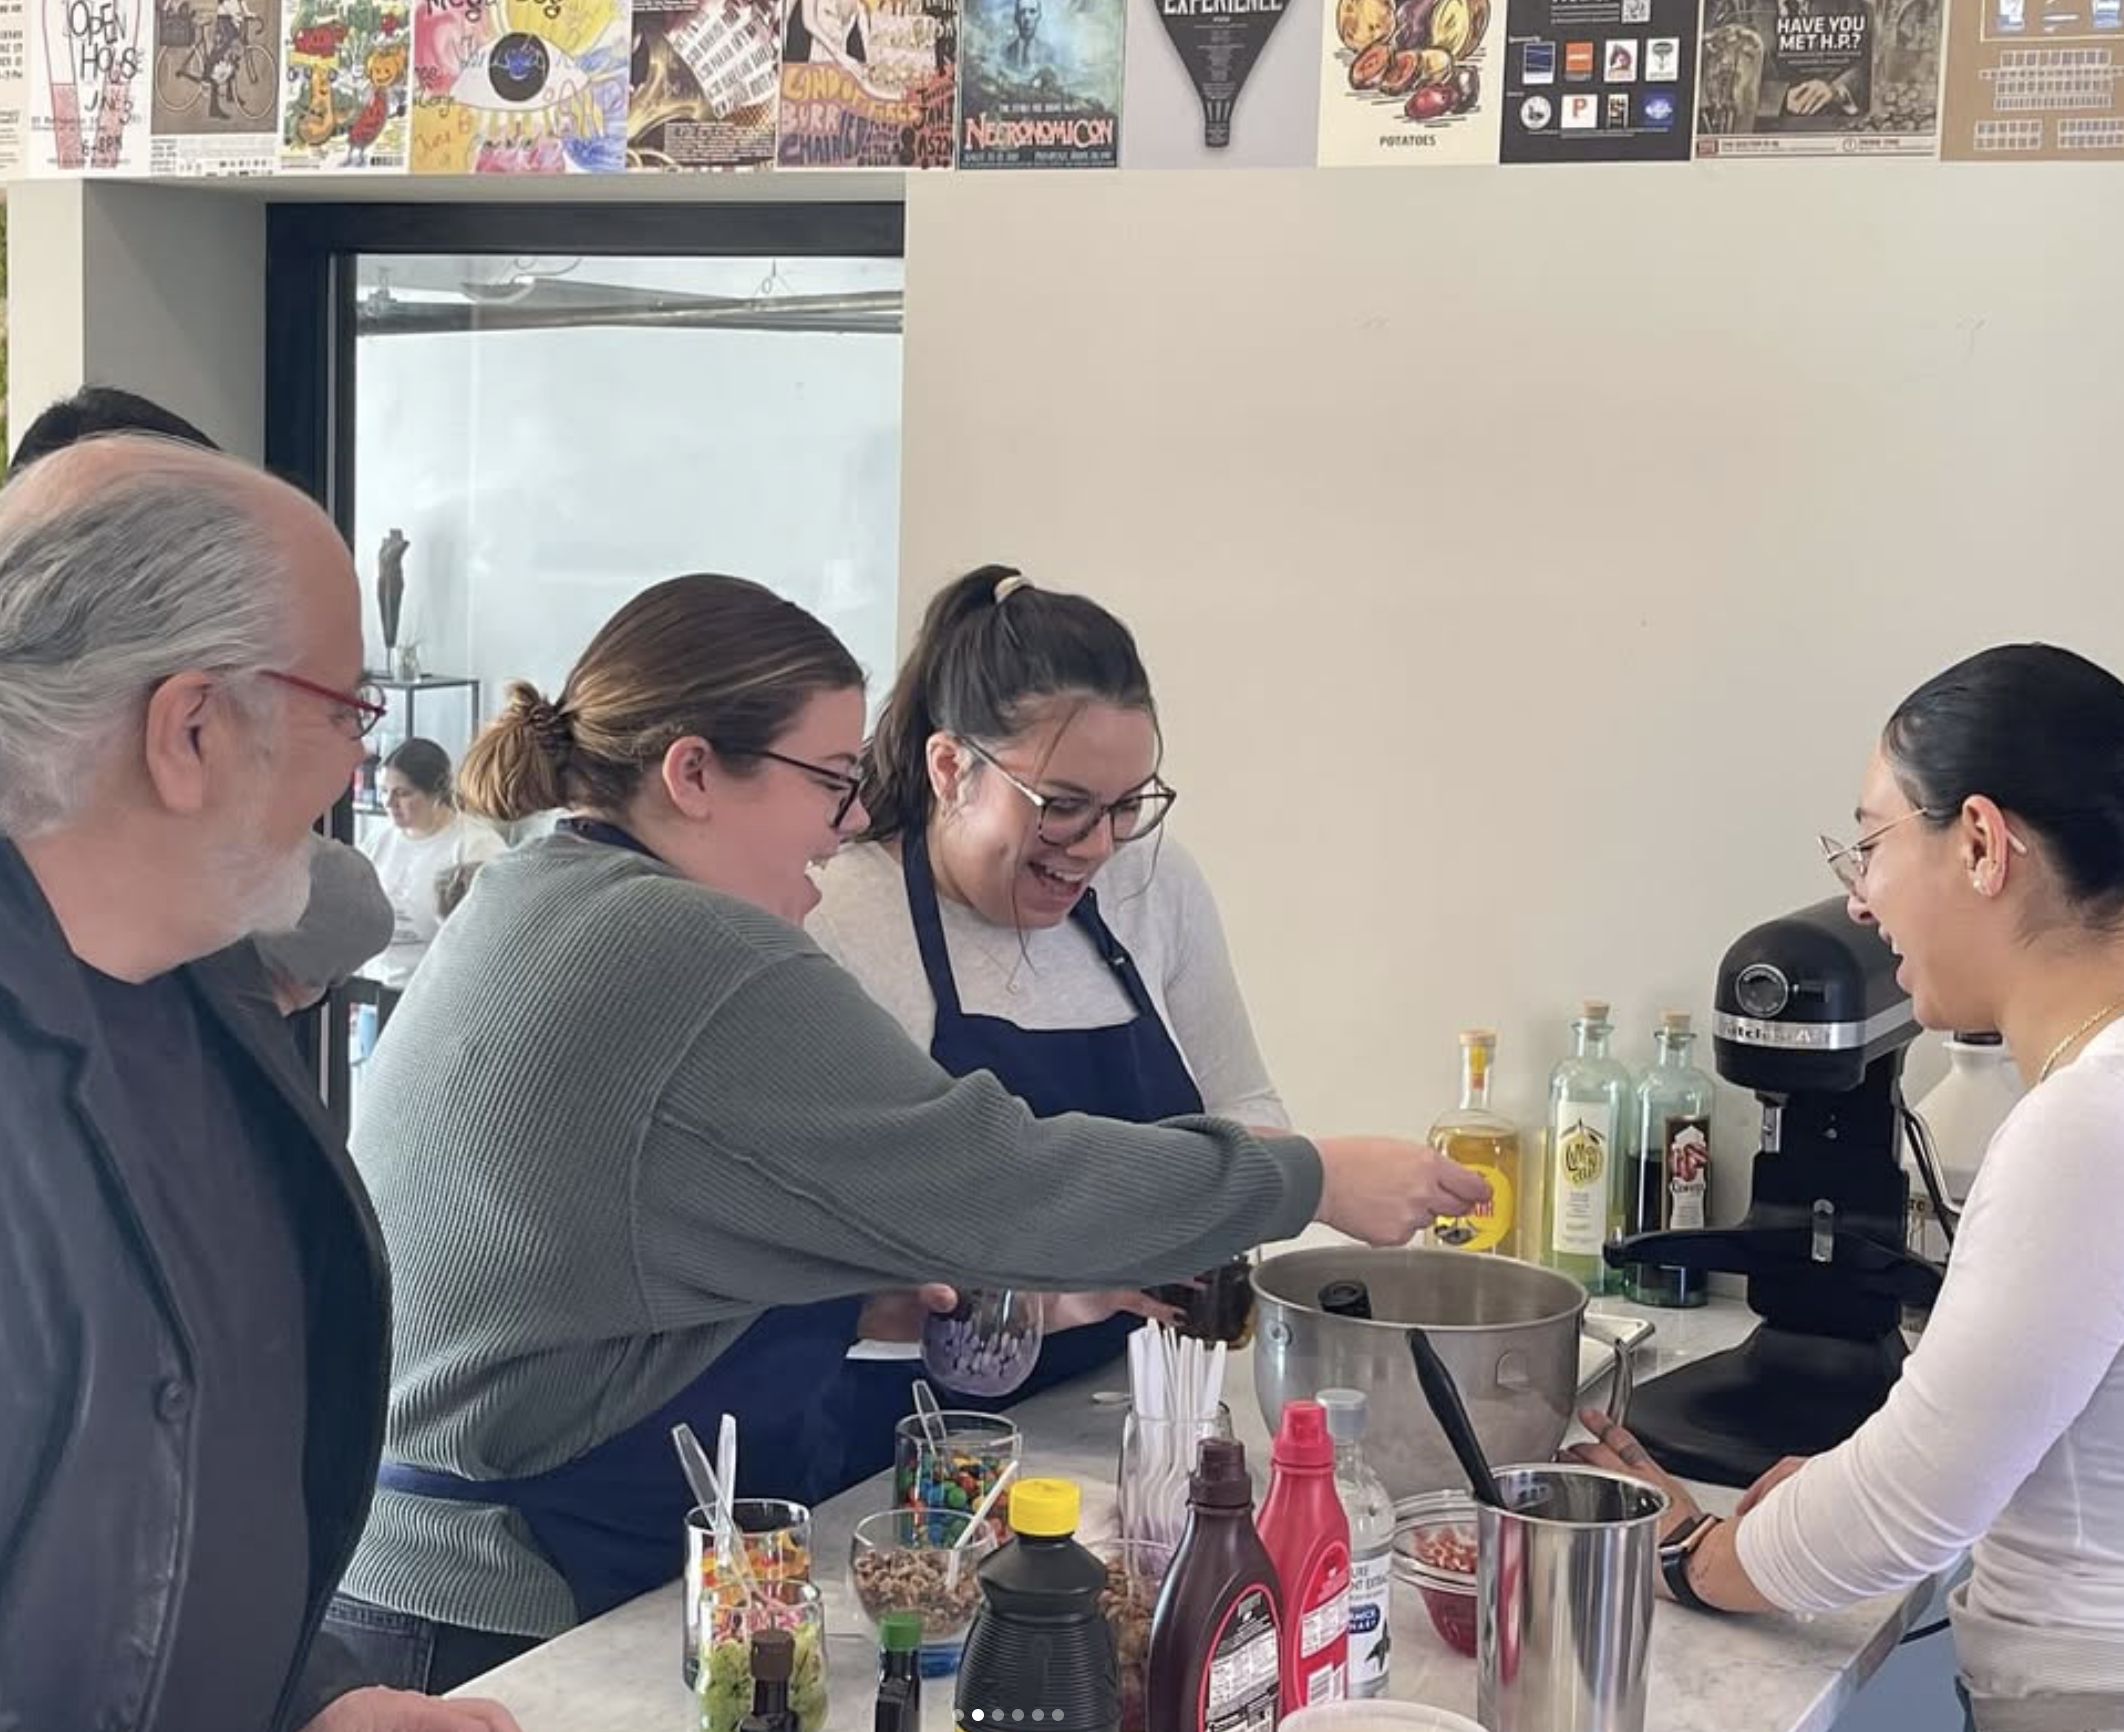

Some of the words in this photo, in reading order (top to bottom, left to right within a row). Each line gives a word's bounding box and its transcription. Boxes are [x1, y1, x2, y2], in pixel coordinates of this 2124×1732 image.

[70, 0, 126, 46] OPEN
[1777, 17, 1825, 35] HAVE
[1828, 15, 1866, 33] YOU
[1779, 33, 1818, 51] MET
[1820, 32, 1861, 50] H.P.?
[80, 42, 144, 84] HOUSE
[1379, 134, 1437, 147] POTATOES
